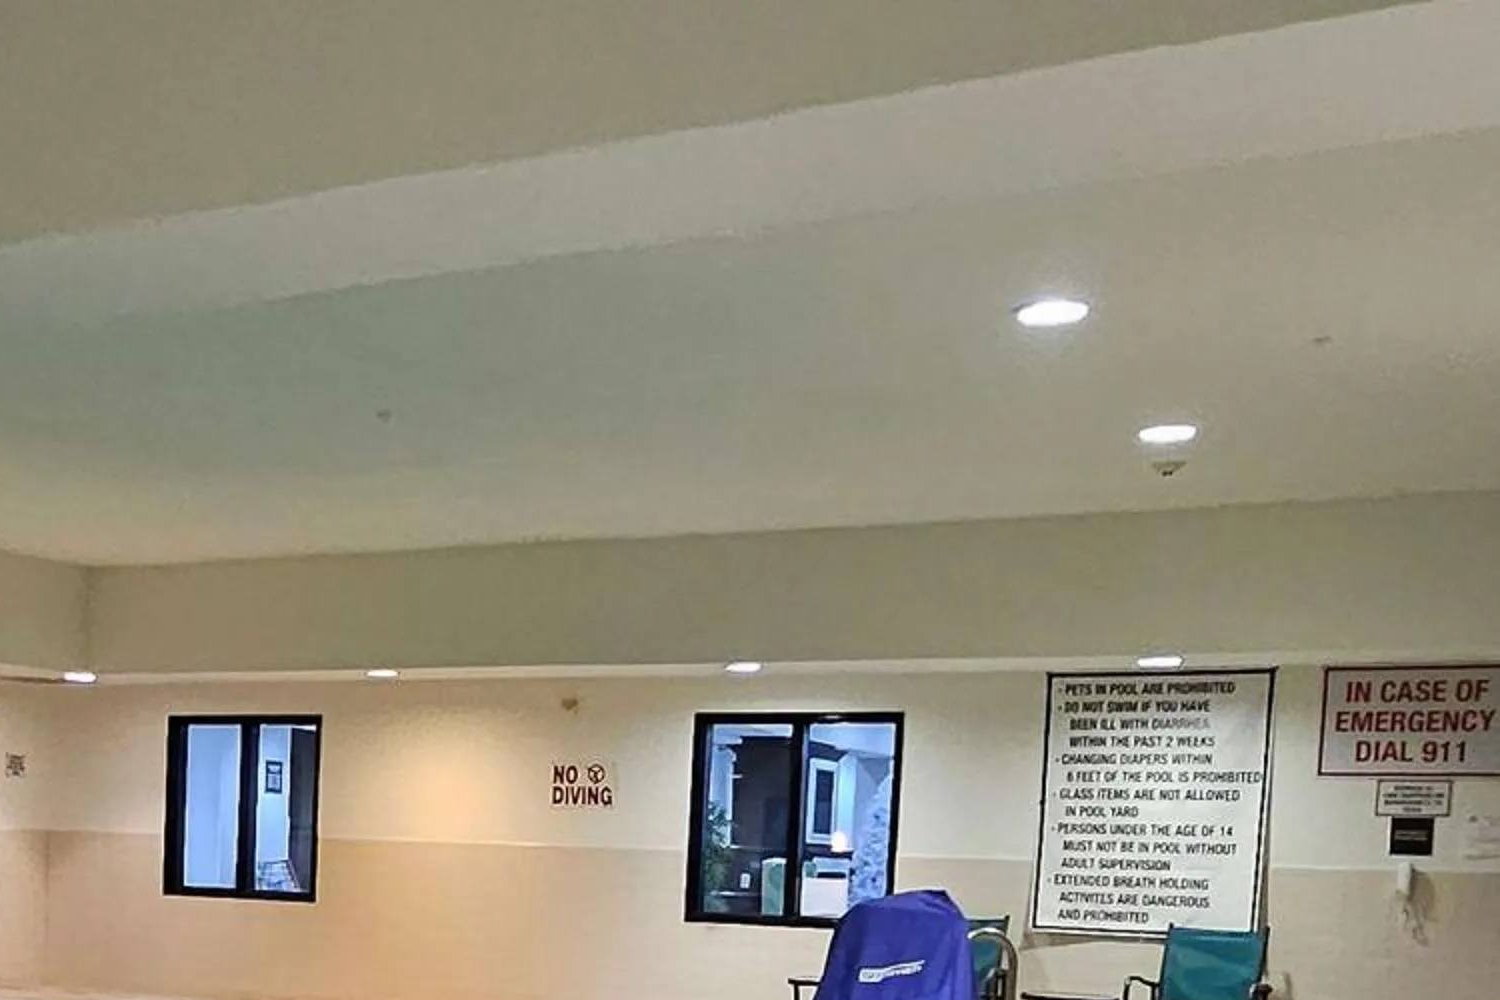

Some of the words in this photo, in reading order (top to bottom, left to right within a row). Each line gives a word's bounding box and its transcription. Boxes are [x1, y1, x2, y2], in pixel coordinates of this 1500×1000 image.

[1065, 684, 1093, 696] PETS
[1095, 684, 1107, 695] IN
[1109, 684, 1137, 695] POOL
[1141, 683, 1163, 695] ARE
[1167, 682, 1236, 695] PROHIBITED
[1346, 681, 1372, 703] IN
[1380, 680, 1448, 703] CASE
[1455, 679, 1490, 703] OF
[1064, 701, 1080, 713] DO
[1082, 701, 1105, 713] NOT
[1107, 701, 1138, 713] SWIM
[1141, 701, 1151, 713] IF
[1155, 701, 1178, 713] YOU
[1180, 699, 1210, 713] HAVE
[1334, 709, 1496, 733] EMERGENCY
[1069, 736, 1107, 748] WITHIN
[1110, 736, 1130, 748] THE
[1133, 736, 1161, 748] PAST
[1166, 736, 1174, 748] 2
[1177, 736, 1216, 748] WEEKS
[1355, 741, 1413, 763] DIAL
[1421, 740, 1467, 763] 911
[1062, 753, 1117, 765] CHANGING
[1120, 753, 1168, 765] DIAPERS
[1171, 753, 1213, 765] WITHIN
[553, 765, 578, 784] NO
[1075, 771, 1101, 783] FEET
[1104, 771, 1118, 783] OF
[1122, 771, 1142, 783] THE
[1146, 771, 1174, 783] POOL
[1178, 771, 1190, 783] IS
[1193, 771, 1261, 784] PROHIBITED
[552, 786, 612, 806] DIVING
[1059, 788, 1094, 800] GLASS
[1097, 788, 1130, 800] ITEMS
[1133, 788, 1156, 801] ARE
[1159, 789, 1181, 801] NOT
[1185, 789, 1241, 802] ALLOWED
[1065, 806, 1077, 817] IN
[1079, 806, 1107, 817] POOL
[1110, 806, 1139, 817] YARD
[1057, 822, 1107, 835] PERSONS
[1109, 823, 1147, 836] UNDER
[1151, 823, 1171, 837] THE
[1175, 824, 1197, 837] AGE
[1201, 825, 1216, 837] OF
[1220, 826, 1234, 837] 14
[1063, 840, 1093, 852] MUST
[1096, 841, 1117, 853] NOT
[1120, 841, 1135, 853] BE
[1138, 842, 1150, 853] IN
[1152, 841, 1181, 855] POOL
[1185, 843, 1237, 855] WITHOUT
[1061, 857, 1095, 869] ADULT
[1098, 858, 1171, 871] SUPERVISION
[1053, 873, 1111, 887] EXTENDED
[1113, 875, 1156, 888] BREATH
[1159, 877, 1209, 890] HOLDING
[1117, 893, 1138, 906] ARE
[1141, 894, 1210, 908] DANGEROUS
[1057, 909, 1080, 920] AND
[1083, 910, 1149, 923] PROHIBITED
